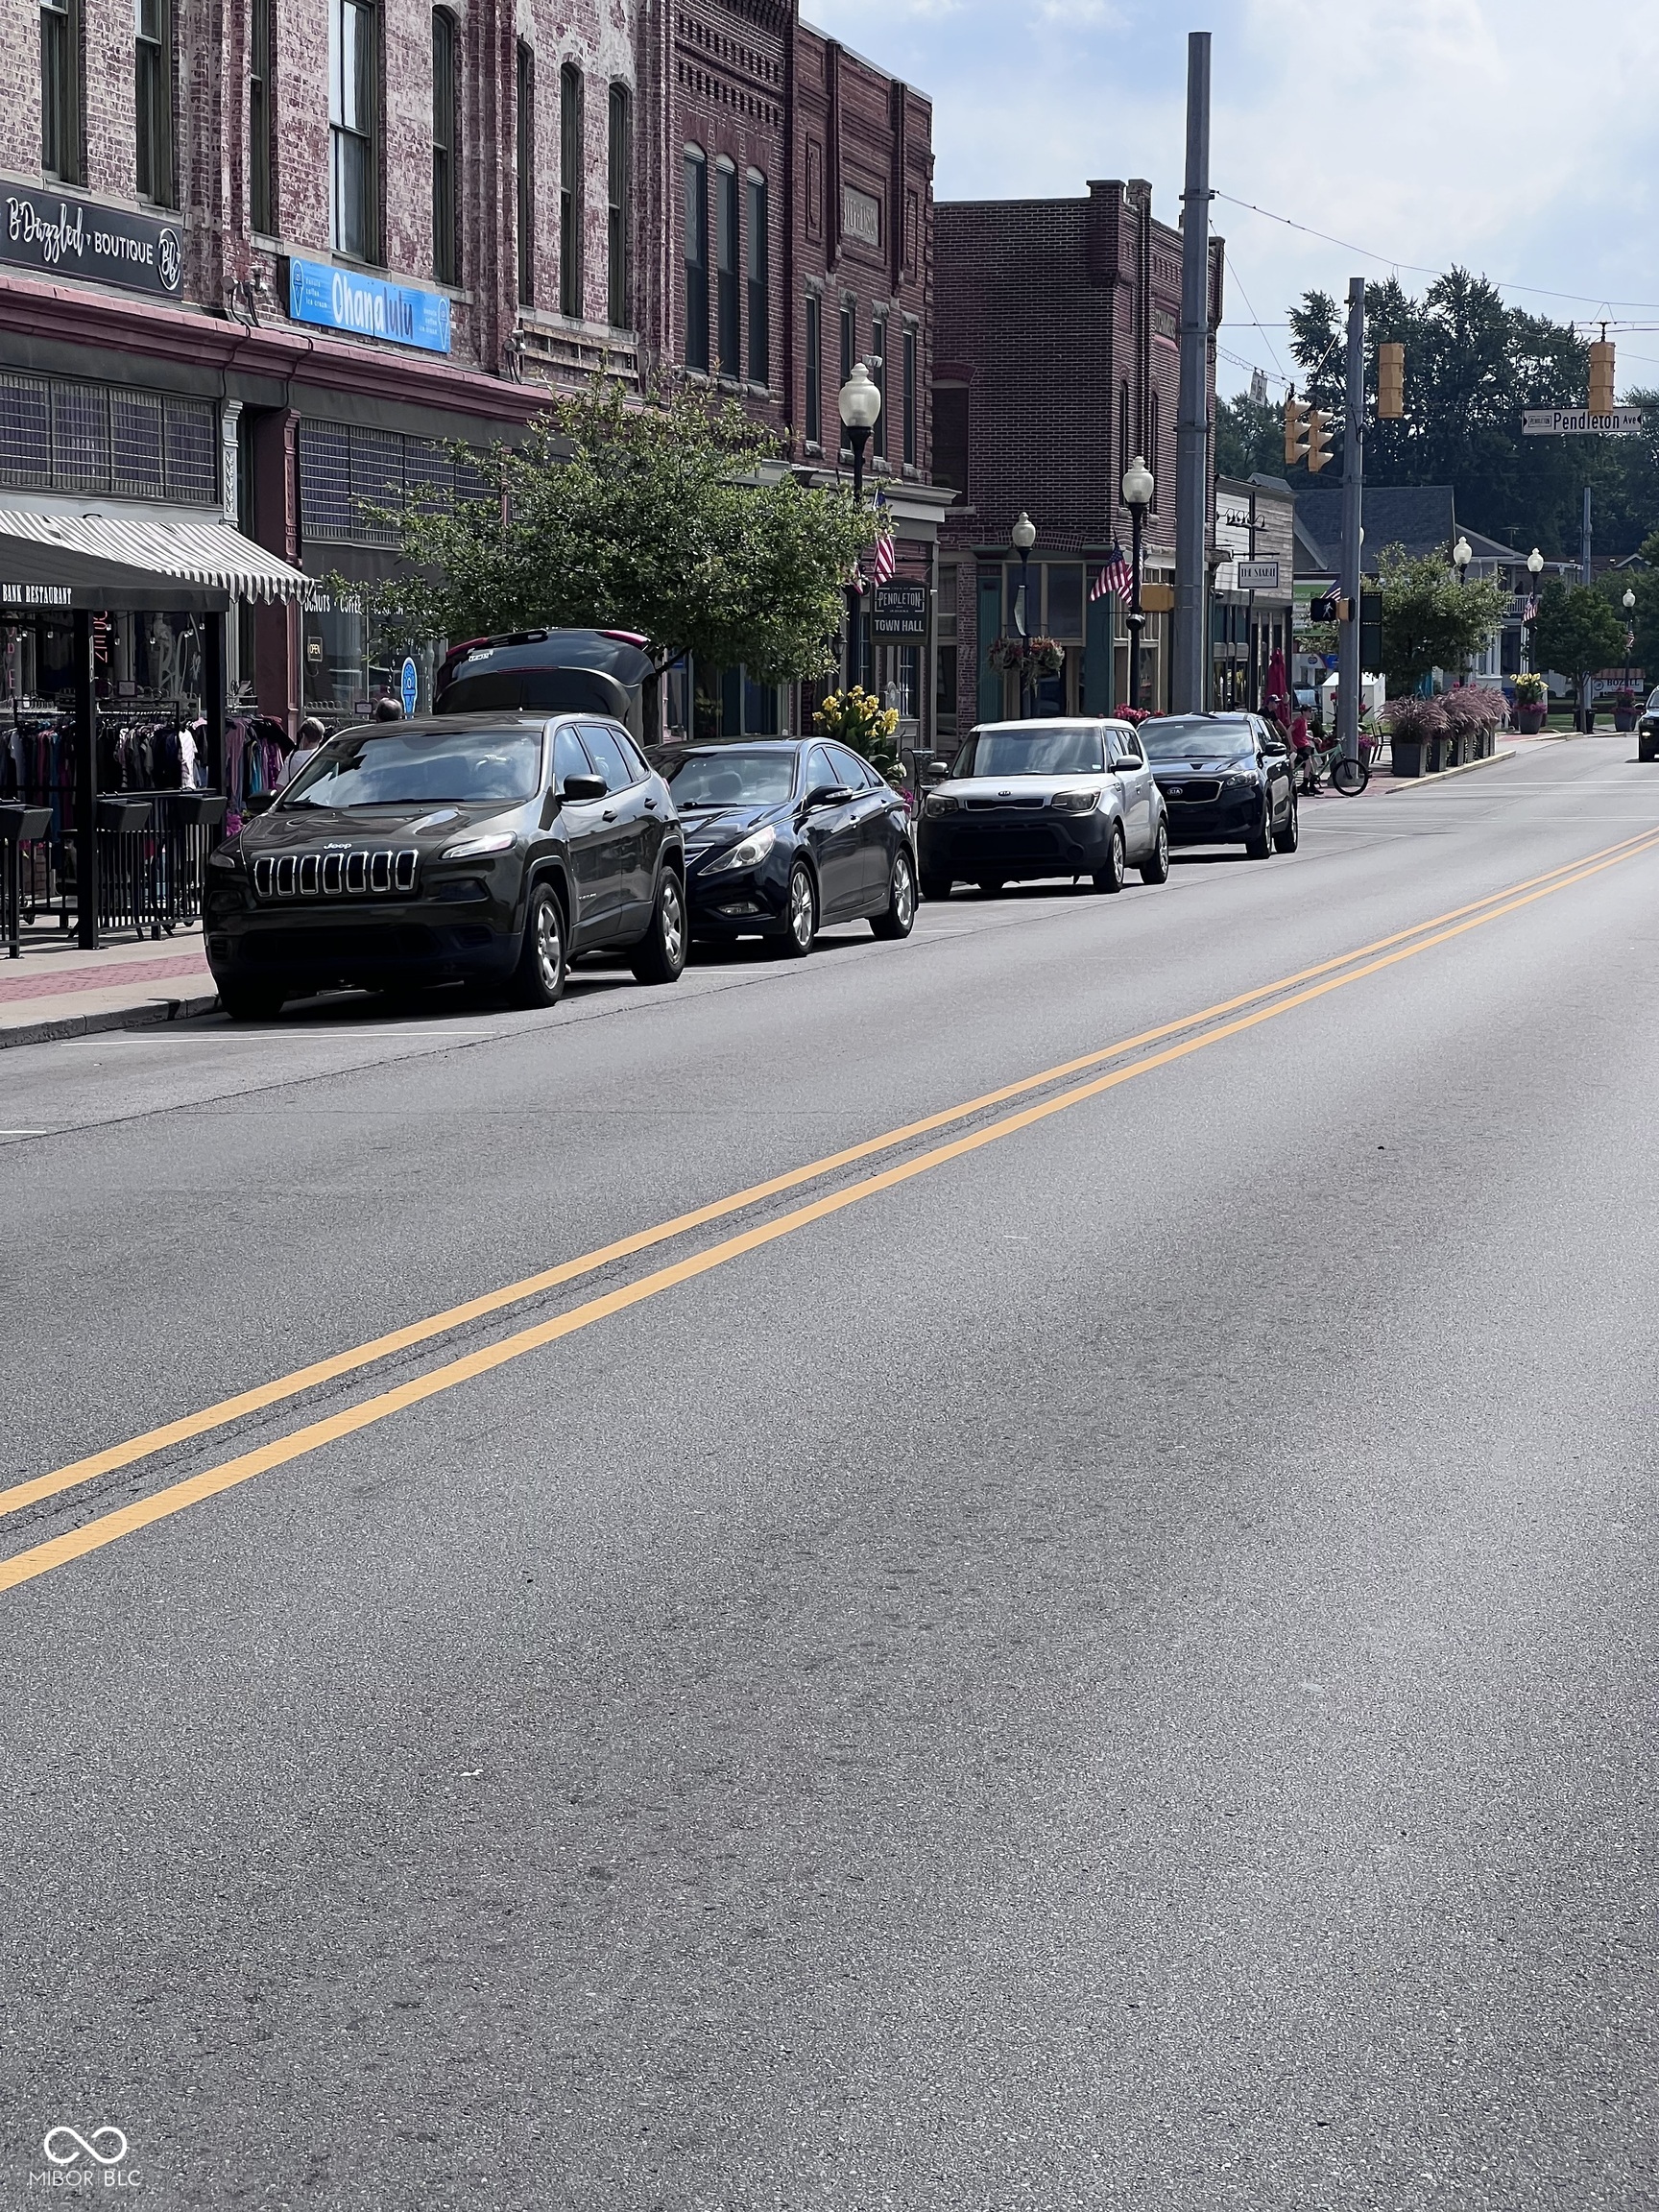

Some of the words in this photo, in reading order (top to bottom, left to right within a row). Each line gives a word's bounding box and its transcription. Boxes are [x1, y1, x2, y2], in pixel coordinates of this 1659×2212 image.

[94, 231, 154, 265] BOUTIQUE
[1553, 412, 1620, 430] Pendleton
[1623, 415, 1636, 424] Ave
[2, 584, 22, 603] BANK
[25, 585, 72, 605] RESTAURANT
[878, 592, 921, 607] PENDLETON
[875, 620, 900, 631] TOWN
[902, 620, 924, 632] HALL
[309, 643, 321, 655] OPEN
[1607, 678, 1640, 686] BOZLL
